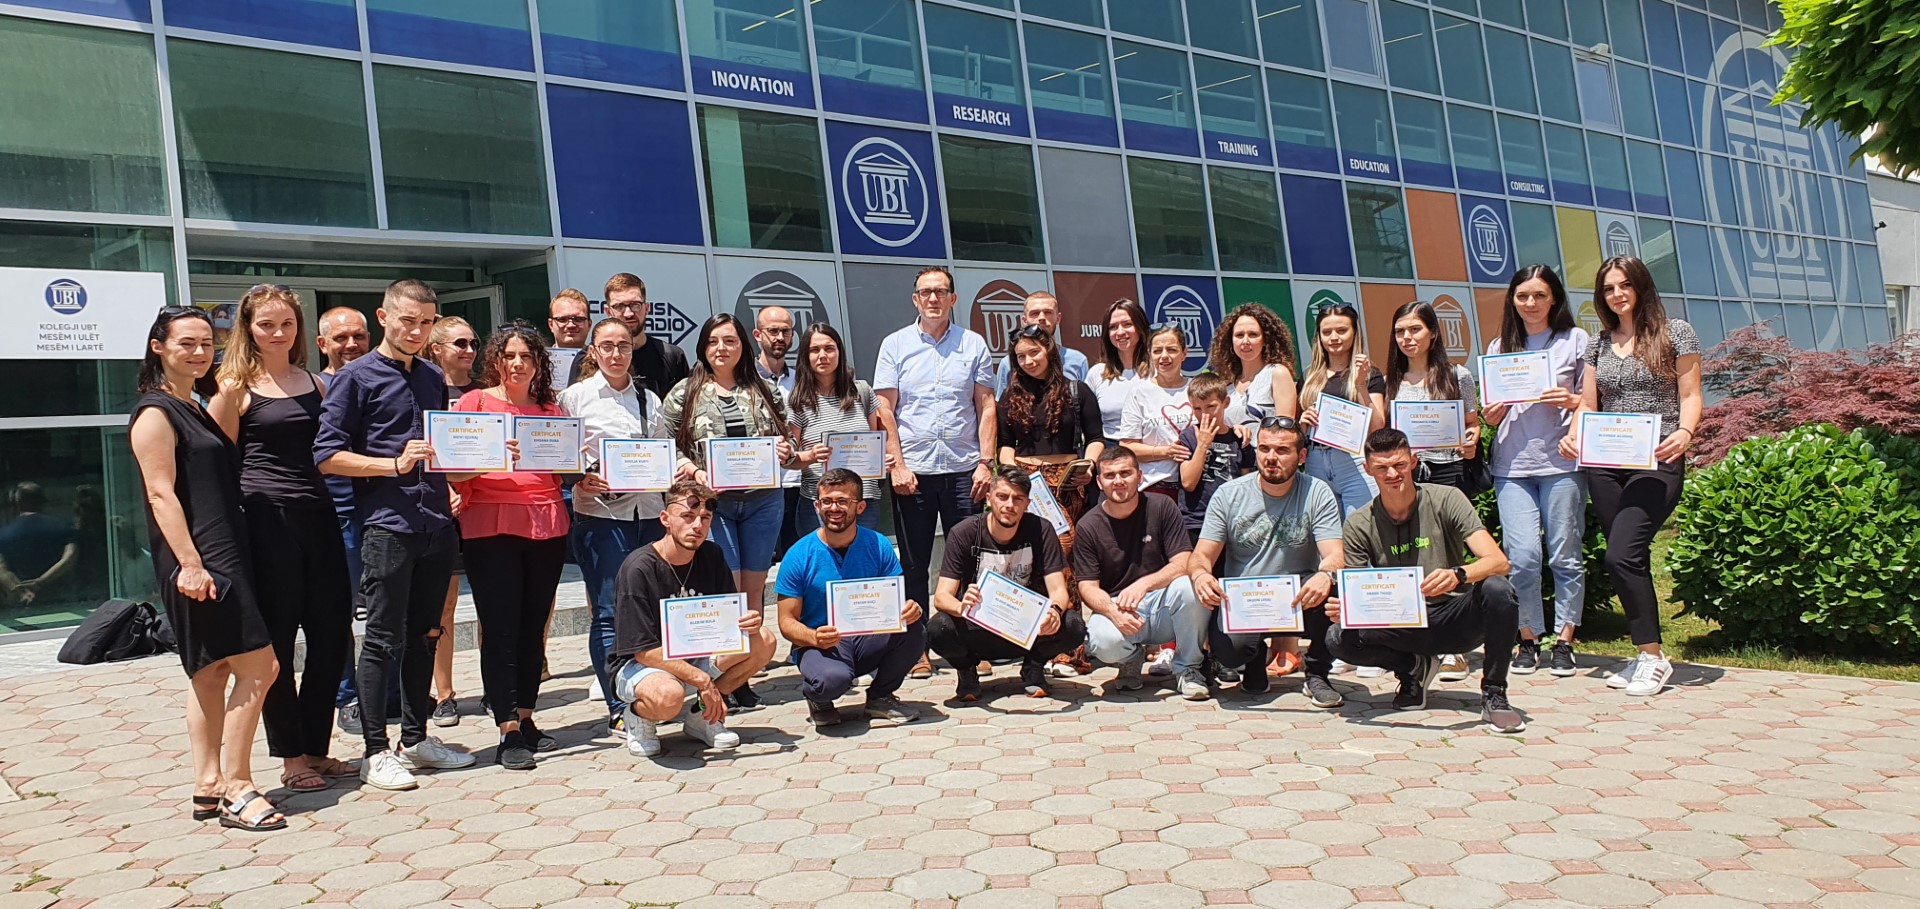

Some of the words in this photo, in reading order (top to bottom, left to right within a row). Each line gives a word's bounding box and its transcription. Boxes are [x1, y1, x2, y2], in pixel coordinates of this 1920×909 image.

[711, 70, 794, 97] INOVATION
[952, 105, 1011, 127] RESEARCH
[1218, 141, 1259, 157] TRAINING
[1350, 158, 1390, 174] EDUCATION
[860, 172, 910, 214] UBT
[1510, 180, 1545, 194] CONSULTING
[1731, 140, 1815, 262] UBT
[1475, 228, 1499, 253] UBT
[52, 289, 81, 305] UBT
[40, 323, 79, 331] KOLEGJI
[39, 332, 71, 340] MESËM
[78, 333, 100, 341] ULËT
[37, 343, 70, 351] MESËM
[76, 343, 104, 351] LARTË
[848, 592, 880, 600] CERTIFICATE
[996, 590, 1025, 608] CERTIFICATE
[685, 611, 720, 619] CERTIFICATE
